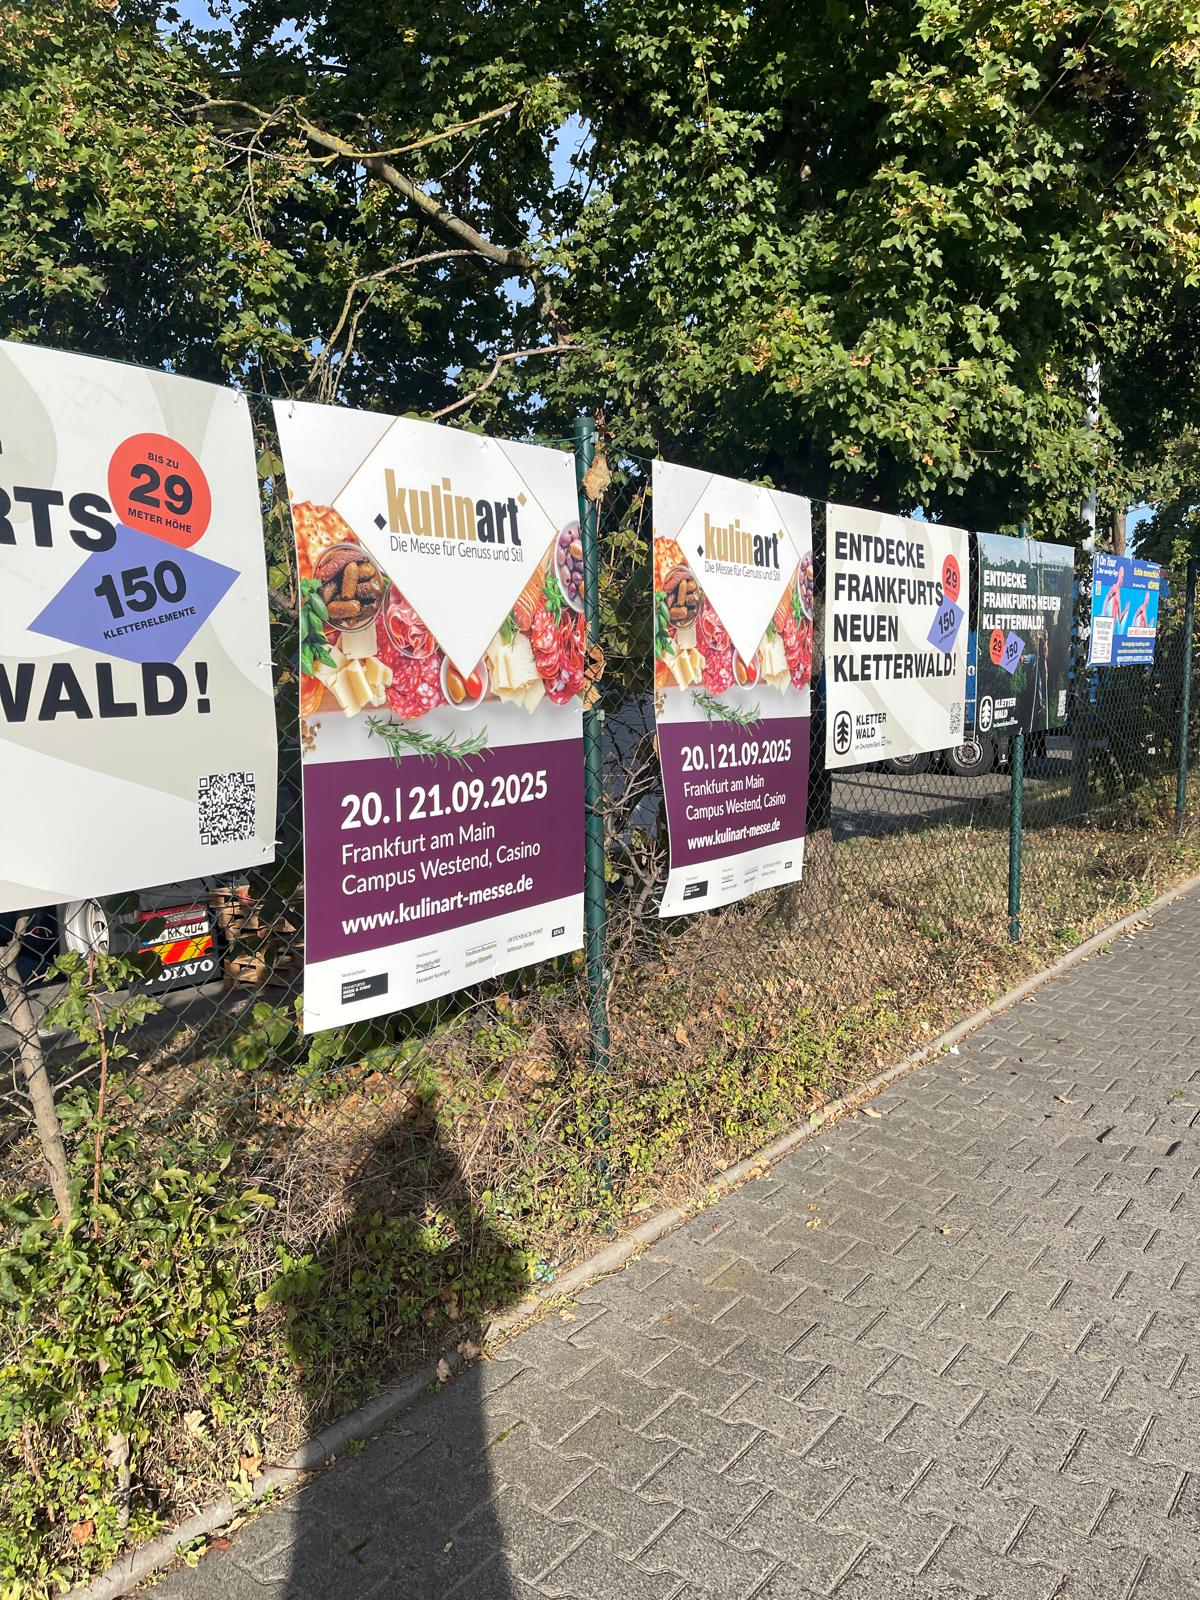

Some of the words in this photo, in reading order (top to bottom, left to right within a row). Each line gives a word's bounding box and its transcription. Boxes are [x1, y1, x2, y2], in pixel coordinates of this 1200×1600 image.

[147, 452, 164, 465] BIS
[166, 457, 179, 469] ZU
[128, 463, 193, 516] 29
[128, 507, 163, 526] METER
[165, 518, 192, 533] HÖHE
[384, 468, 522, 546] kulinart
[390, 535, 407, 551] Die
[410, 537, 441, 556] Messe
[443, 540, 456, 556] für
[458, 542, 491, 559] Genuss
[493, 546, 510, 561] und
[511, 547, 524, 563] Stil
[704, 512, 780, 569] kulinart
[835, 531, 925, 569] ENTDECKE
[705, 561, 714, 573] Die
[716, 562, 733, 576] Messe
[742, 566, 762, 580] Genuss
[762, 569, 773, 581] und
[945, 567, 958, 589] 29
[983, 569, 1027, 589] ENTDECKE
[94, 560, 187, 619] 150
[834, 572, 944, 607] FRANKFURTS
[983, 592, 1036, 610] FRANKFURTS
[1037, 595, 1061, 611] NEUEN
[103, 606, 196, 639] KLETTERELEMENTE
[833, 613, 899, 643] NEUEN
[938, 608, 955, 635] 150
[982, 613, 1045, 630] KLETTERWALD!
[993, 637, 1002, 653] 29
[1006, 641, 1018, 660] 150
[833, 653, 957, 683] KLETTERWALD!
[994, 697, 1016, 709] KLETTER
[994, 709, 1008, 720] WALD
[856, 712, 887, 726] KLETTER
[856, 727, 876, 740] WALD
[718, 739, 792, 769] 21.09.2025
[408, 770, 548, 821] 21.09.2025
[684, 779, 729, 798] Frankfurt
[730, 780, 744, 792] am
[745, 774, 765, 790] Main
[686, 804, 724, 821] Campus
[726, 795, 763, 815] Westend,
[764, 792, 786, 808] Casino
[342, 833, 426, 865] Frankfurt
[430, 832, 454, 850] am
[459, 822, 495, 845] Main
[687, 817, 781, 851] www.kulinart-messe.de
[342, 868, 416, 896] Campus
[420, 850, 493, 880] Westend,
[497, 840, 541, 864] Casino
[341, 874, 533, 936] www.kulinart-messe.de
[145, 959, 214, 985] OLVO
